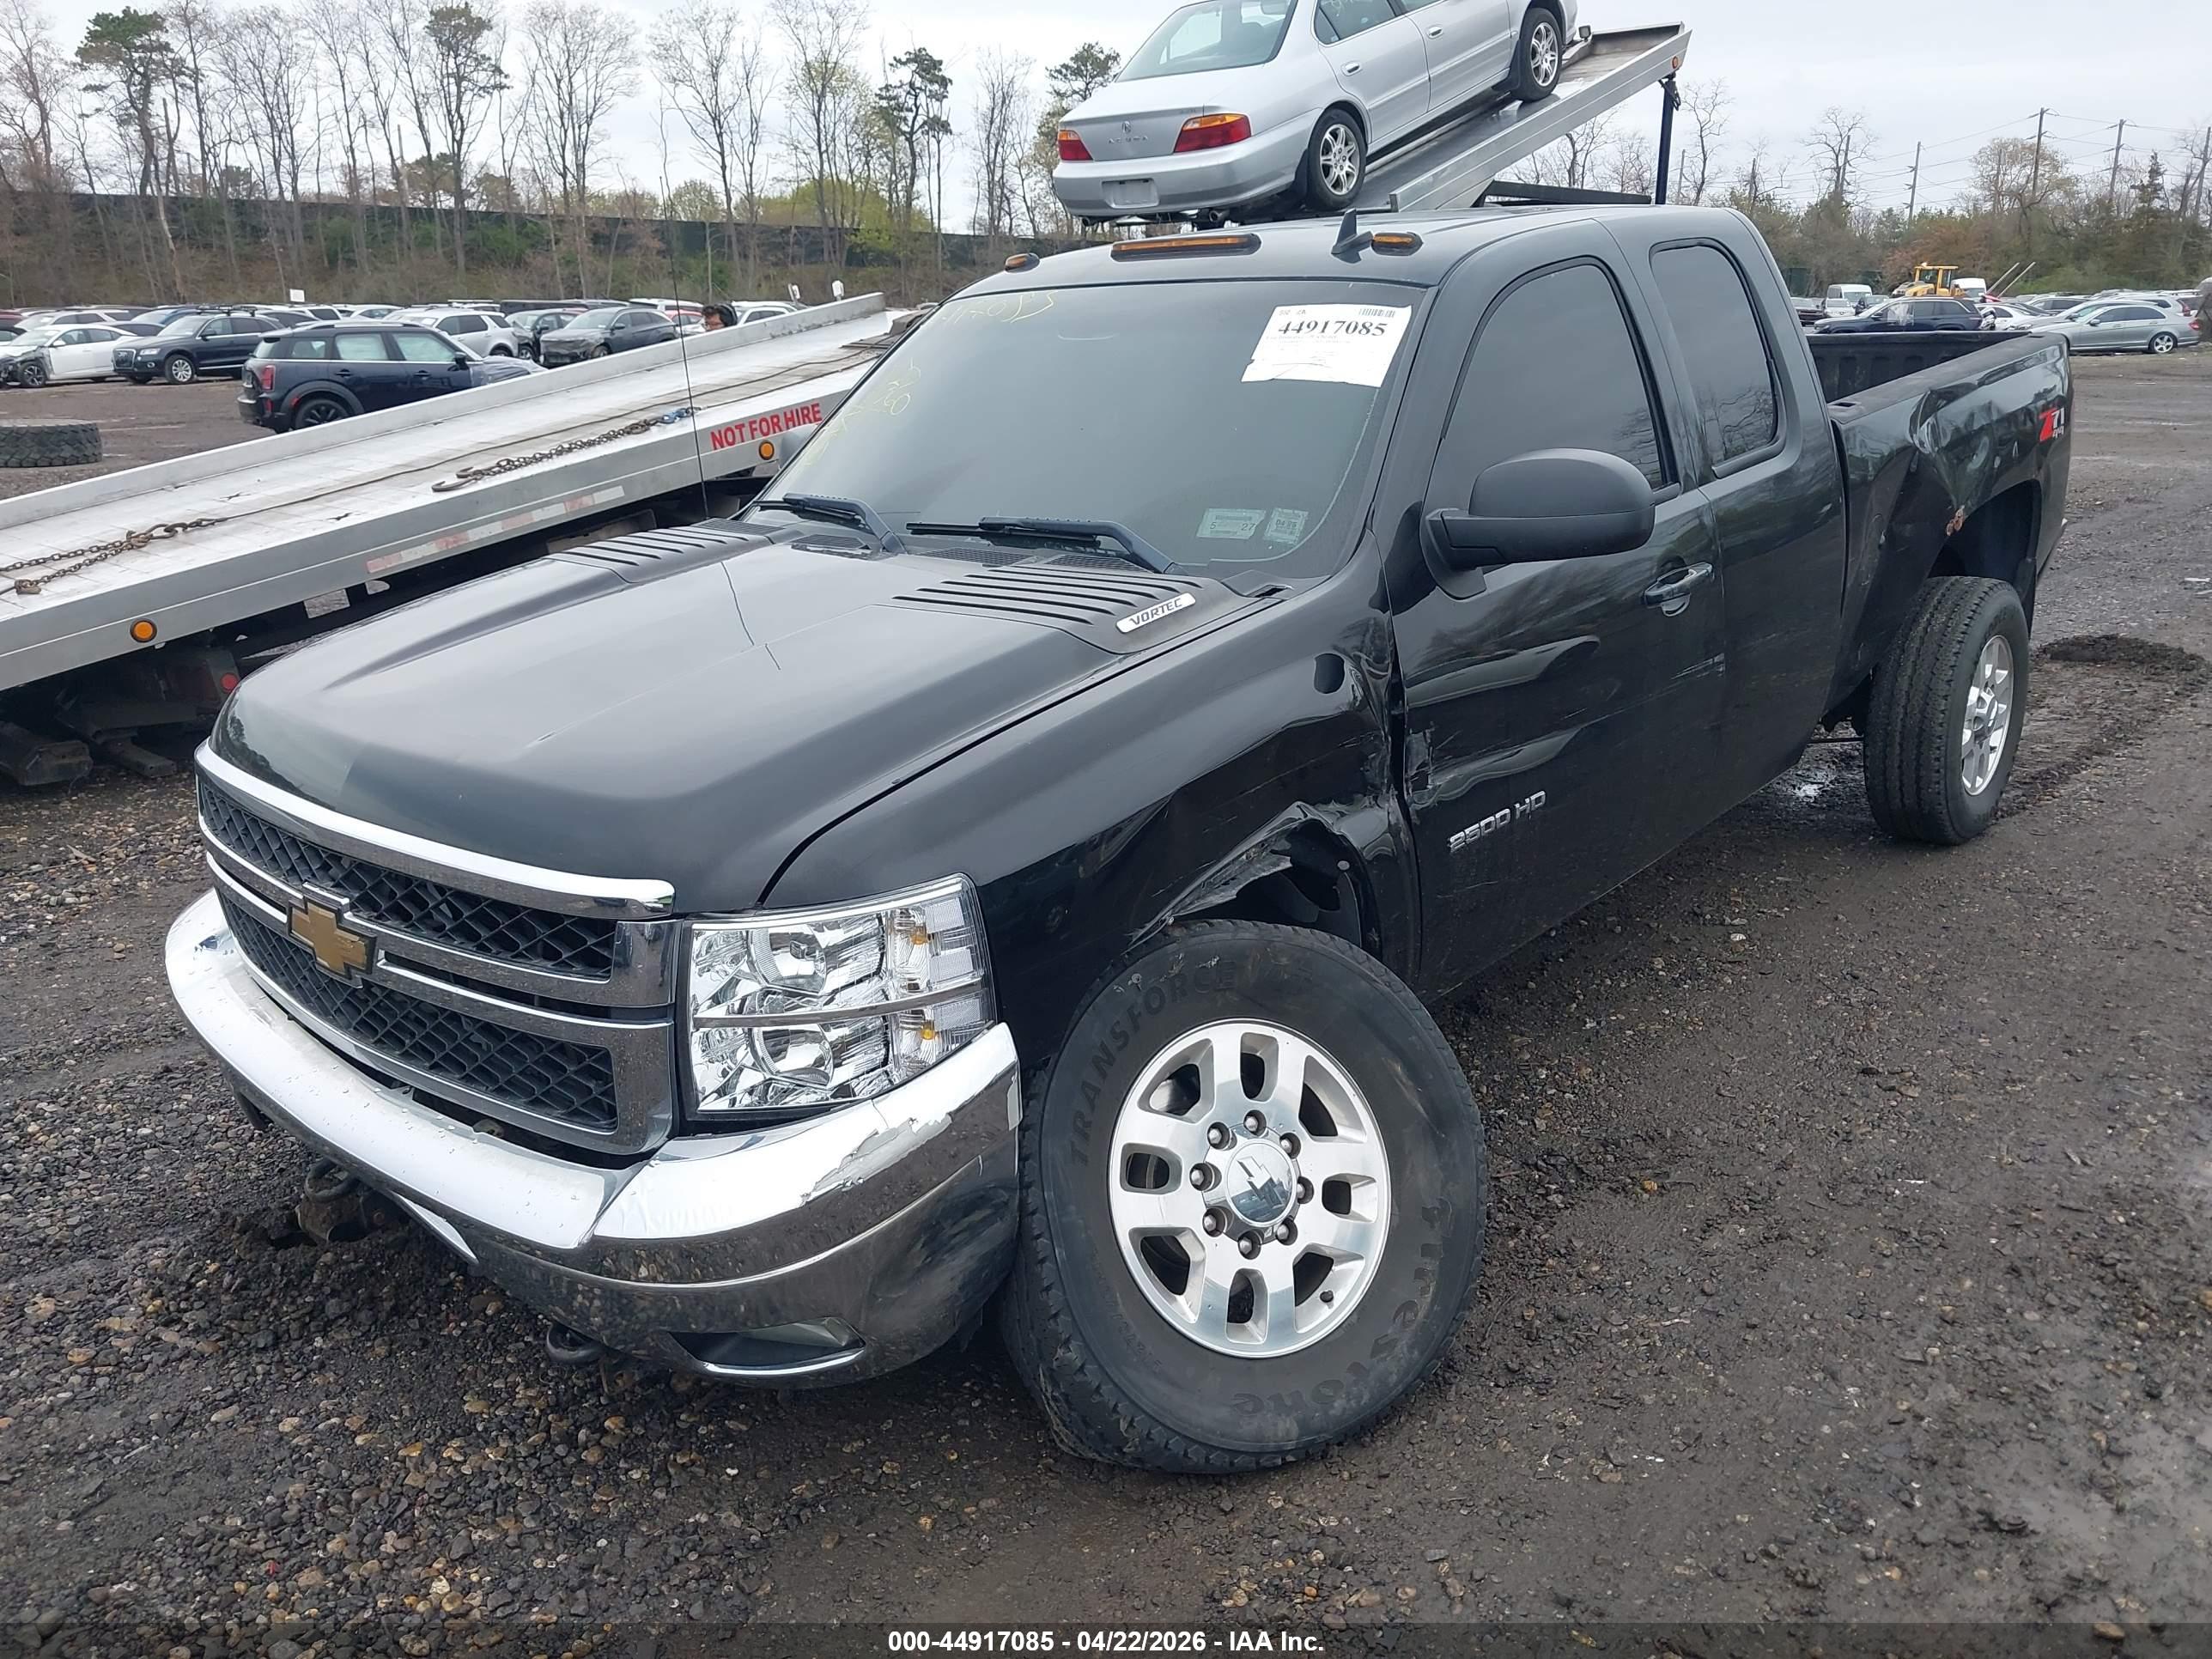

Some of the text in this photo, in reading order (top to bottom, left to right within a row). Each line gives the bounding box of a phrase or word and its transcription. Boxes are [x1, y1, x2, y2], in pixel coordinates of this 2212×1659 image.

[1278, 319, 1389, 337] 44917085
[710, 402, 823, 451] NOT FOR HIRE
[1128, 597, 1183, 626] VORTEC
[1448, 790, 1547, 854] 2500 HD
[1070, 959, 1237, 1167] TRANSFORCE
